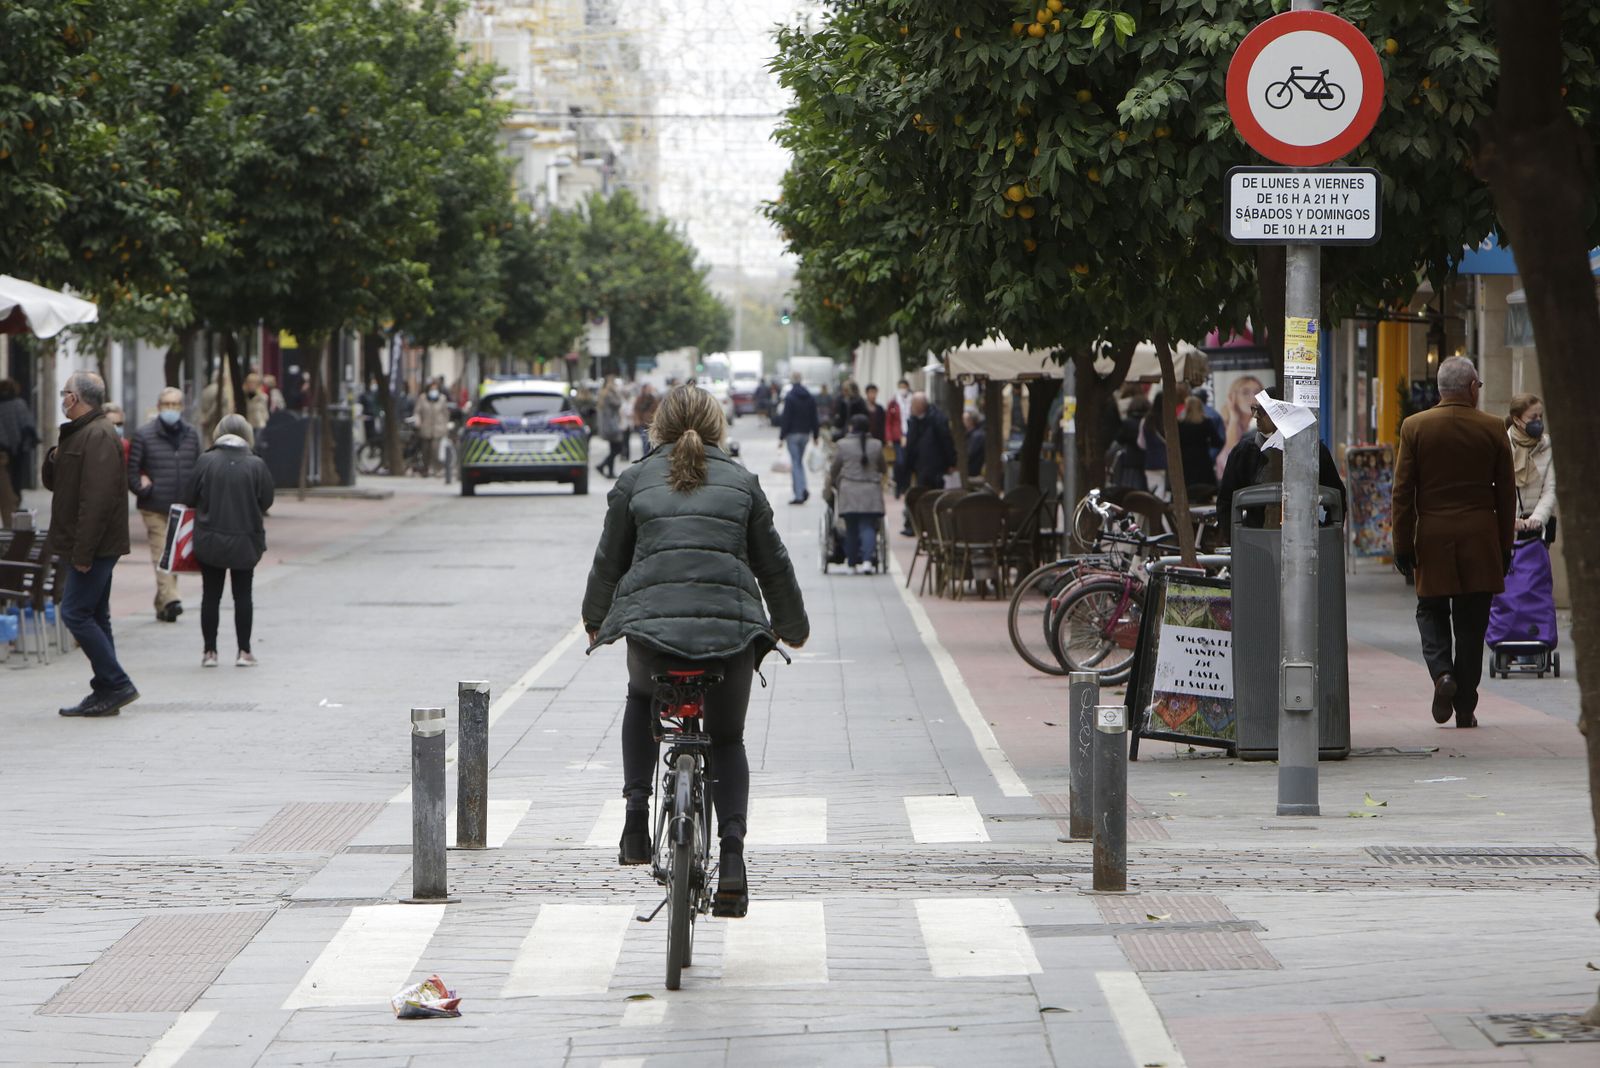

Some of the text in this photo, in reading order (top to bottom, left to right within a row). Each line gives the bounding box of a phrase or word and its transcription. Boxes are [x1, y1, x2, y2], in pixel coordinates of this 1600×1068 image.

[1242, 178, 1365, 189] DE LUNES A VIERNES
[1257, 193, 1349, 204] DE 16 H A 21 H Y
[1235, 205, 1370, 220] SÁBADOS Y DOMINGOS
[1263, 224, 1345, 235] DE 10 H A 21 H
